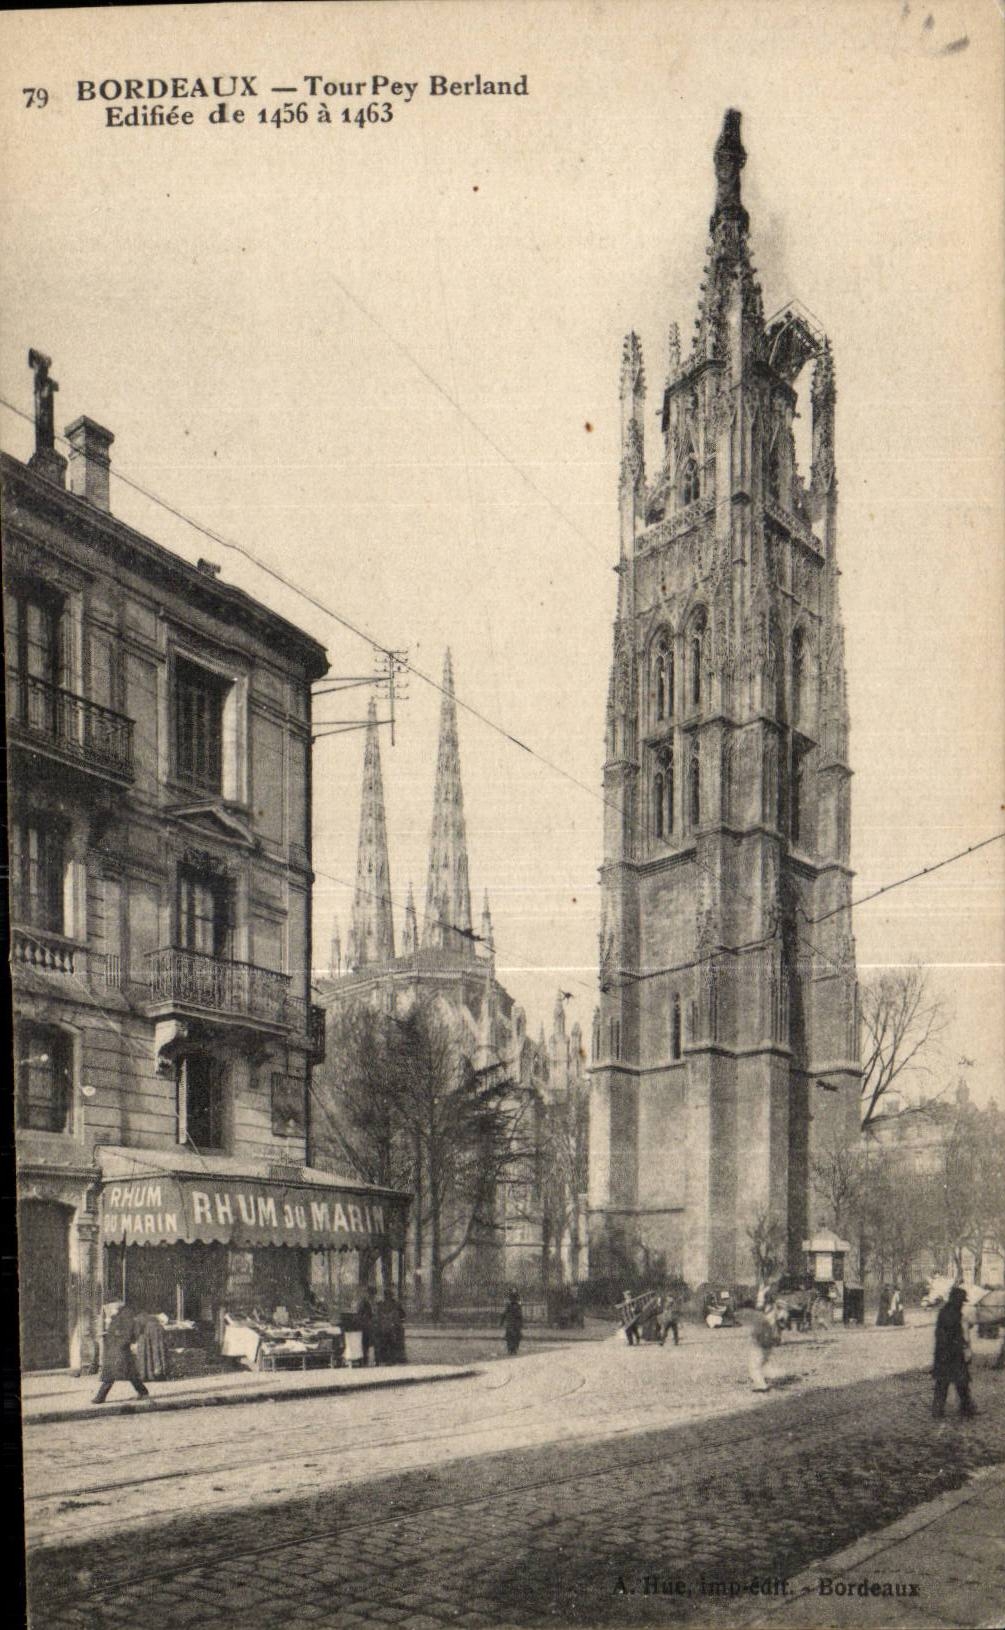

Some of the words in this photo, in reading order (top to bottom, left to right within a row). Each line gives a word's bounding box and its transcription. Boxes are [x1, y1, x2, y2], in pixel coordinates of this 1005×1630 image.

[110, 1185, 162, 1207] RHUM
[121, 1212, 178, 1233] MARIN
[192, 1190, 278, 1228] RHUM
[310, 1201, 386, 1234] MARIN
